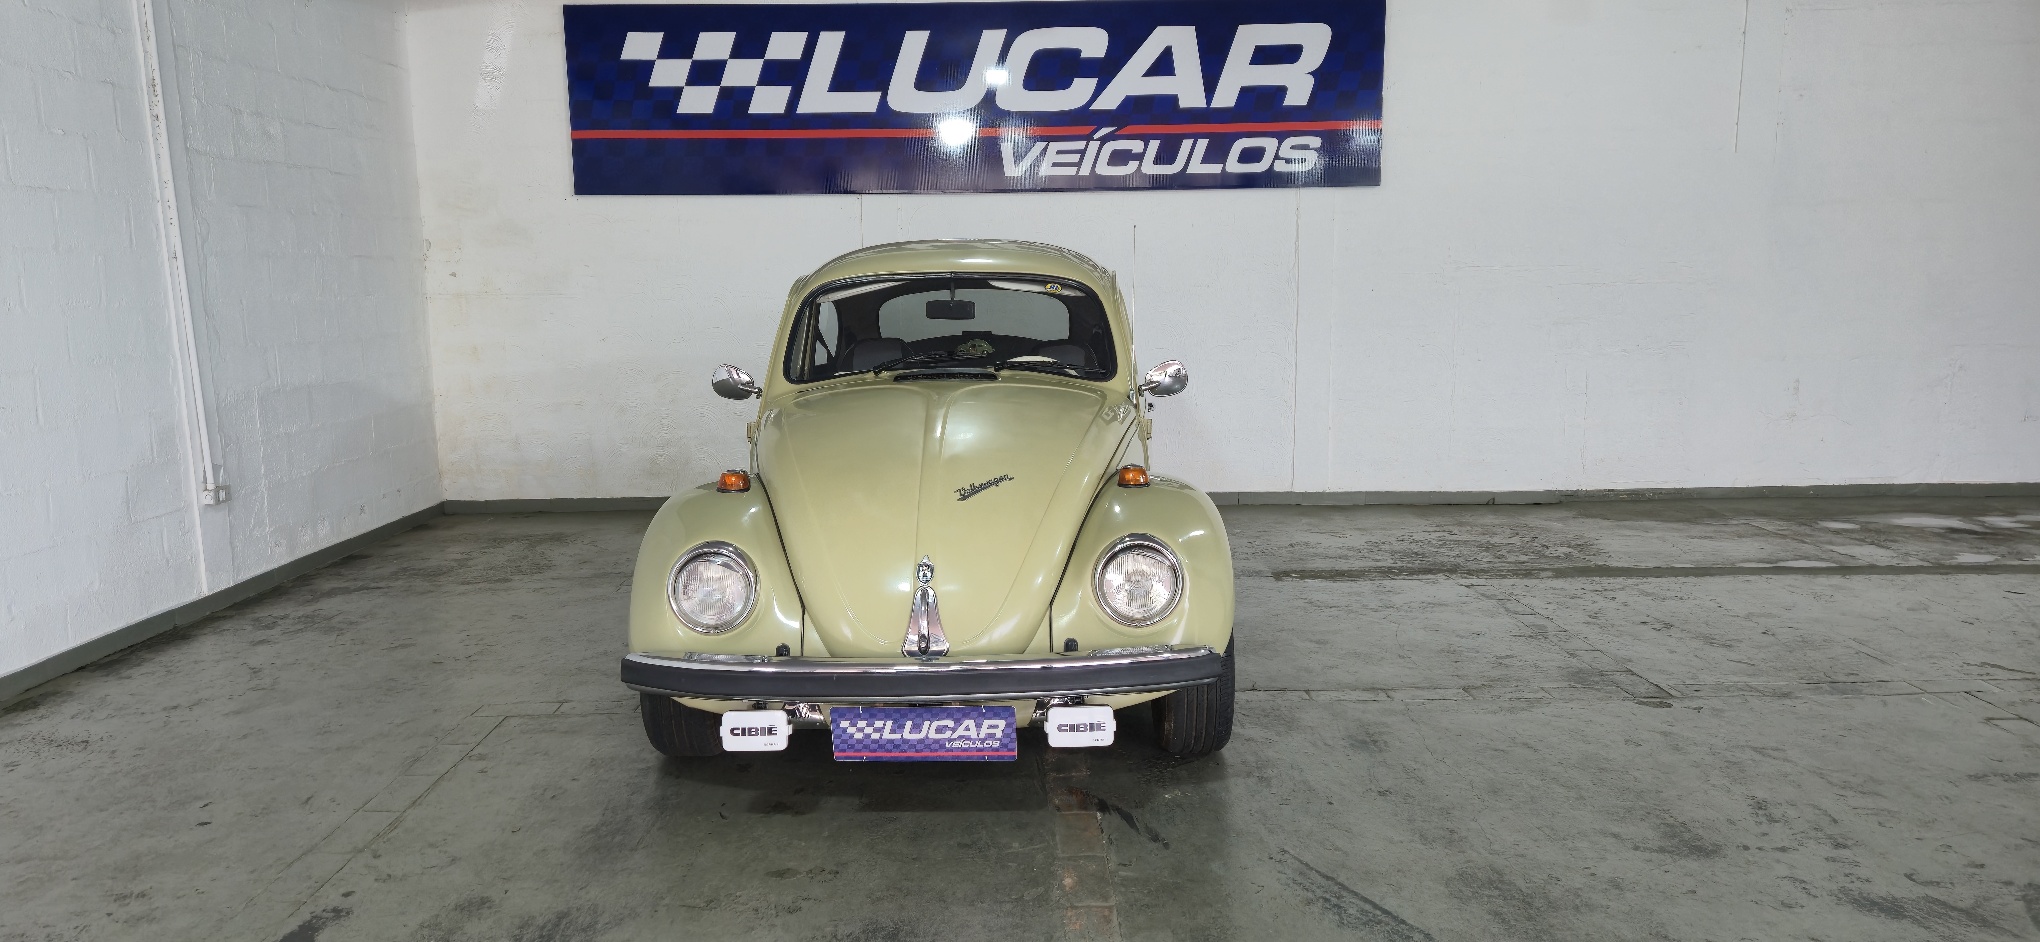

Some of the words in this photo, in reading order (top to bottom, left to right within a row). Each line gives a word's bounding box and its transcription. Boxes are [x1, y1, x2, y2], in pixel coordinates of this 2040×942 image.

[797, 22, 1332, 114] LUCAR
[1000, 127, 1322, 177] VEÍCULOS
[882, 719, 1006, 739] LUCAR
